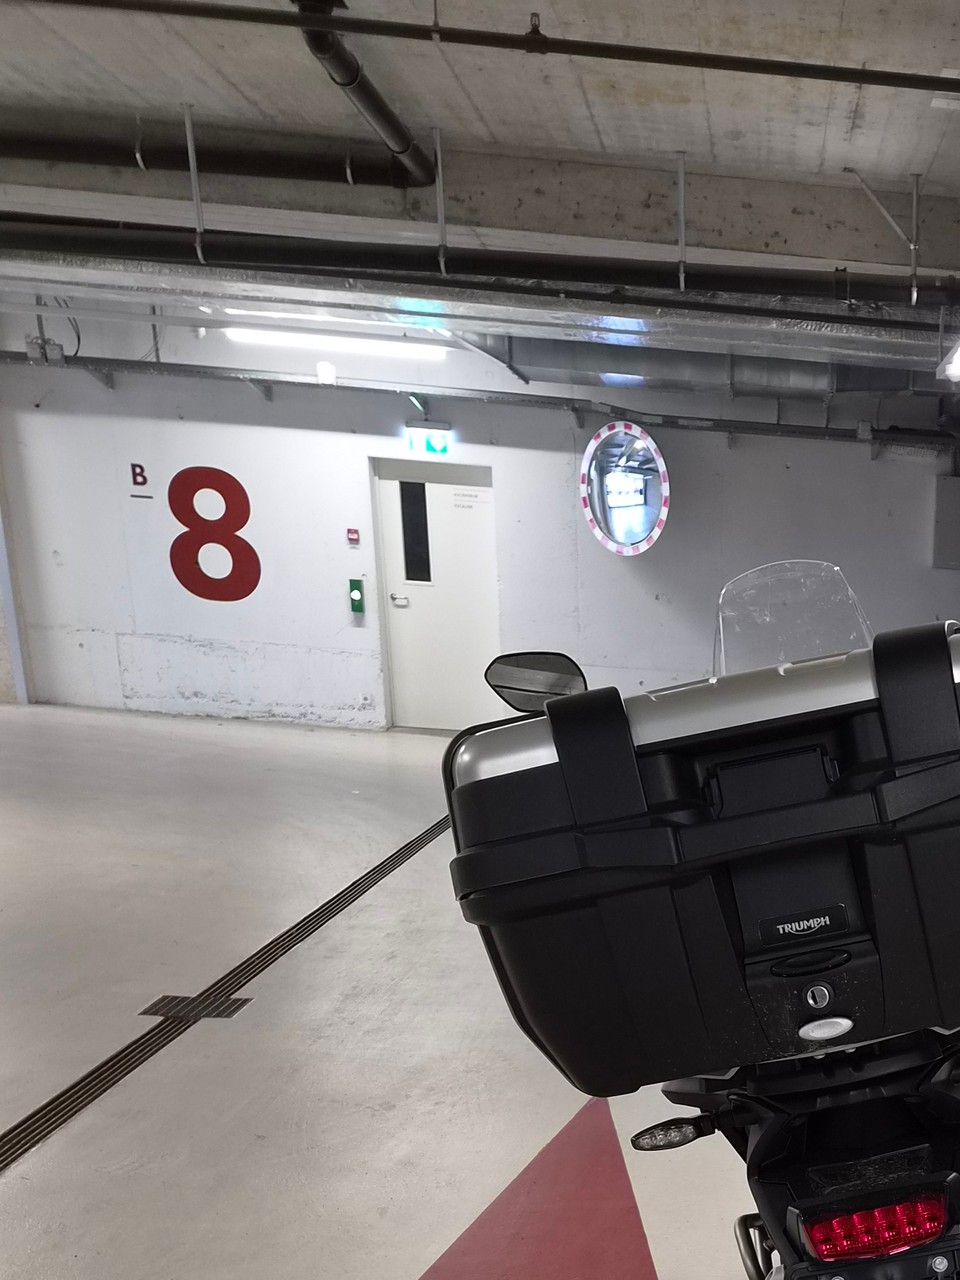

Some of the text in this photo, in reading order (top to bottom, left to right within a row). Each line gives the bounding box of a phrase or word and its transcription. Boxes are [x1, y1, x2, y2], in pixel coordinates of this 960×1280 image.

[130, 463, 148, 486] B
[168, 466, 262, 602] 8
[776, 916, 831, 935] TRIUMPH
